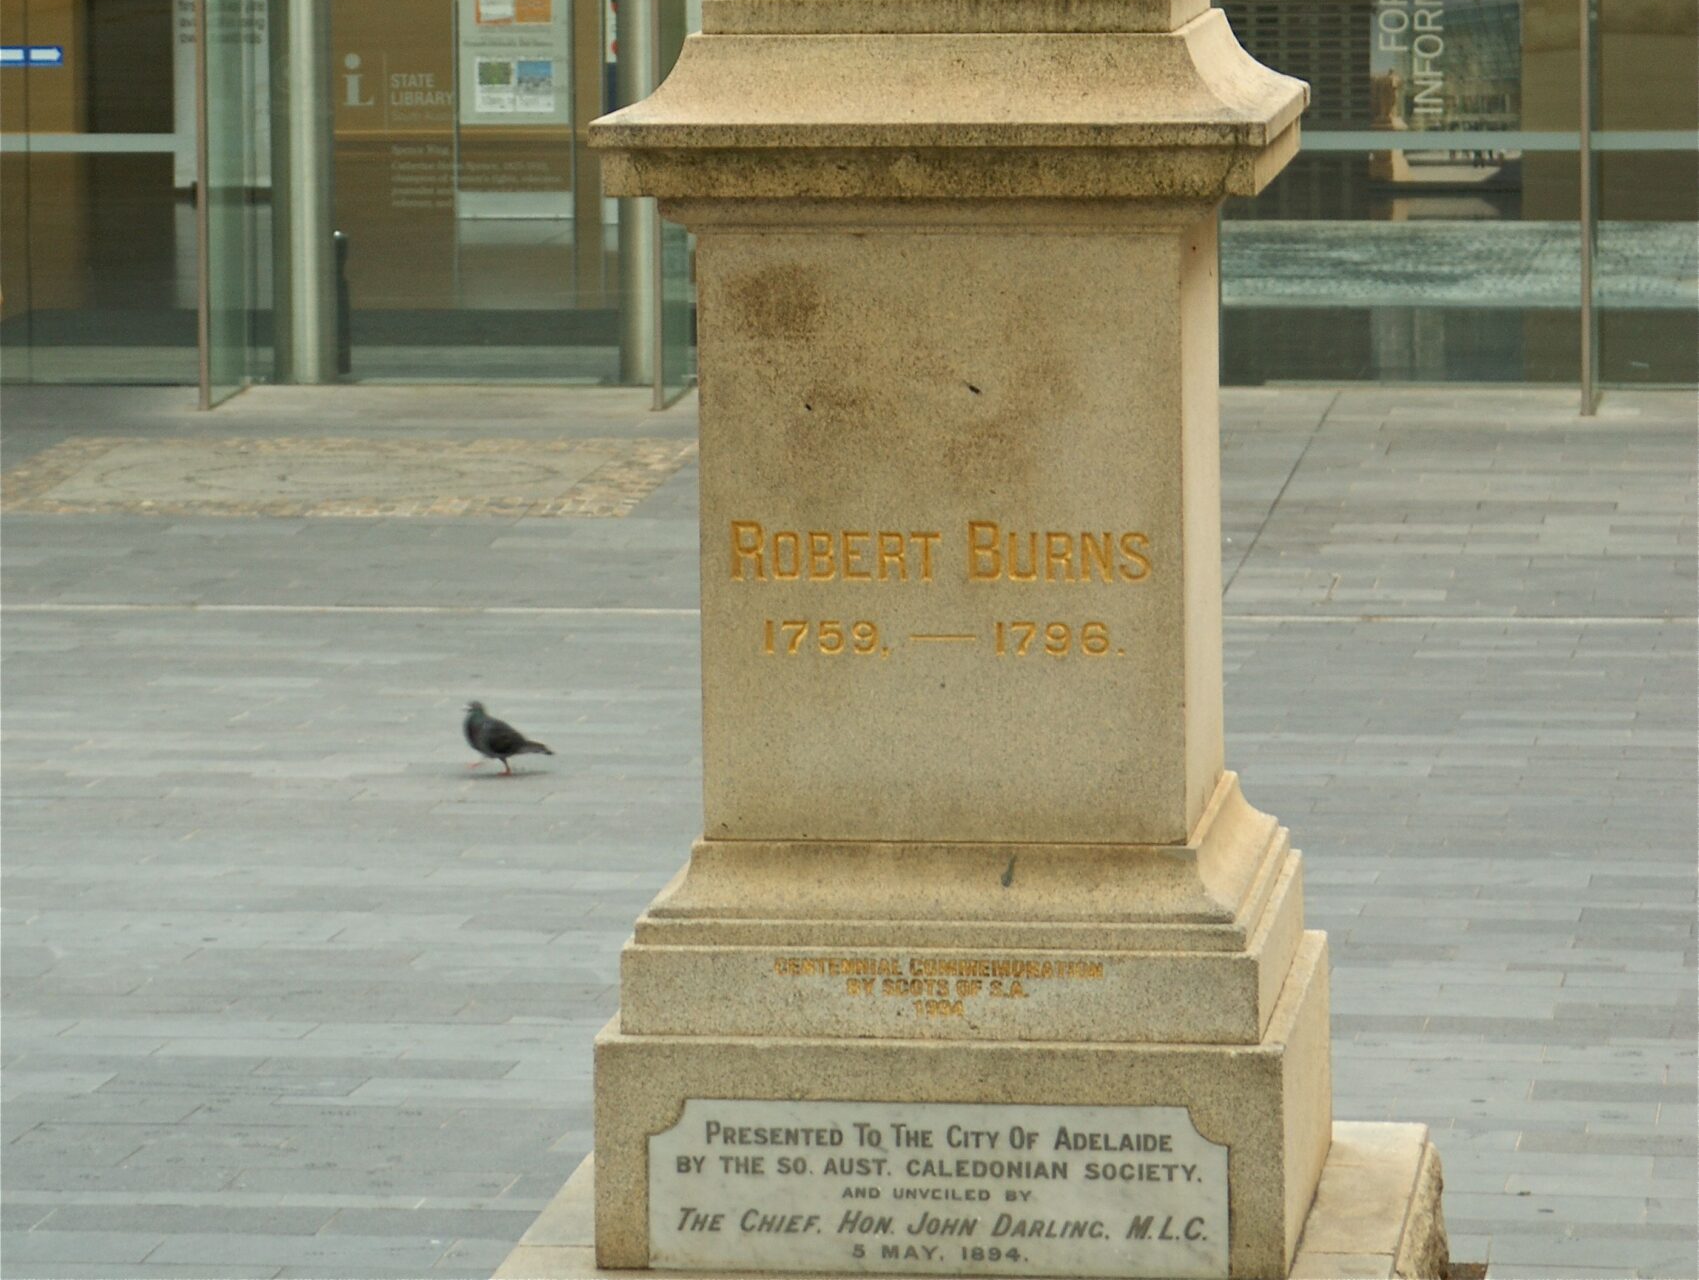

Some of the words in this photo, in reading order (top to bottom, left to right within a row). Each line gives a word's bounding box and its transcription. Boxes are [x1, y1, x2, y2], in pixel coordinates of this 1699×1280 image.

[391, 73, 434, 89] STATE
[391, 90, 454, 106] LIBRARY
[731, 520, 941, 583] ROBERT
[968, 521, 1152, 584] BURNS
[763, 620, 891, 658] 1759,
[994, 622, 1125, 657] 1796.
[774, 957, 903, 977] CENTENNIAL
[846, 978, 875, 997] BY
[882, 979, 949, 997] SCOTS
[956, 979, 983, 998] OF
[989, 980, 1029, 999] S.A.
[706, 1120, 843, 1147] PRESENTED
[853, 1122, 882, 1148] TO
[891, 1123, 933, 1149] THE
[946, 1124, 999, 1150] CITY
[1009, 1126, 1039, 1151] OF
[1054, 1126, 1173, 1153] ADELAIDE
[676, 1155, 705, 1174] BY
[719, 1156, 765, 1175] THE
[777, 1157, 814, 1176] SO.
[823, 1158, 892, 1177] AUST.
[906, 1159, 1068, 1180] CALEDONIAN
[1084, 1163, 1203, 1183] SOCIETY.
[842, 1187, 881, 1199] AND
[1005, 1190, 1032, 1202] BY
[676, 1207, 725, 1232] THE
[837, 1210, 895, 1235] HON.
[907, 1212, 978, 1237] JOHN
[1125, 1216, 1208, 1241] M.L.C.
[852, 1243, 866, 1259] 5
[961, 1246, 1029, 1262] 1894.
